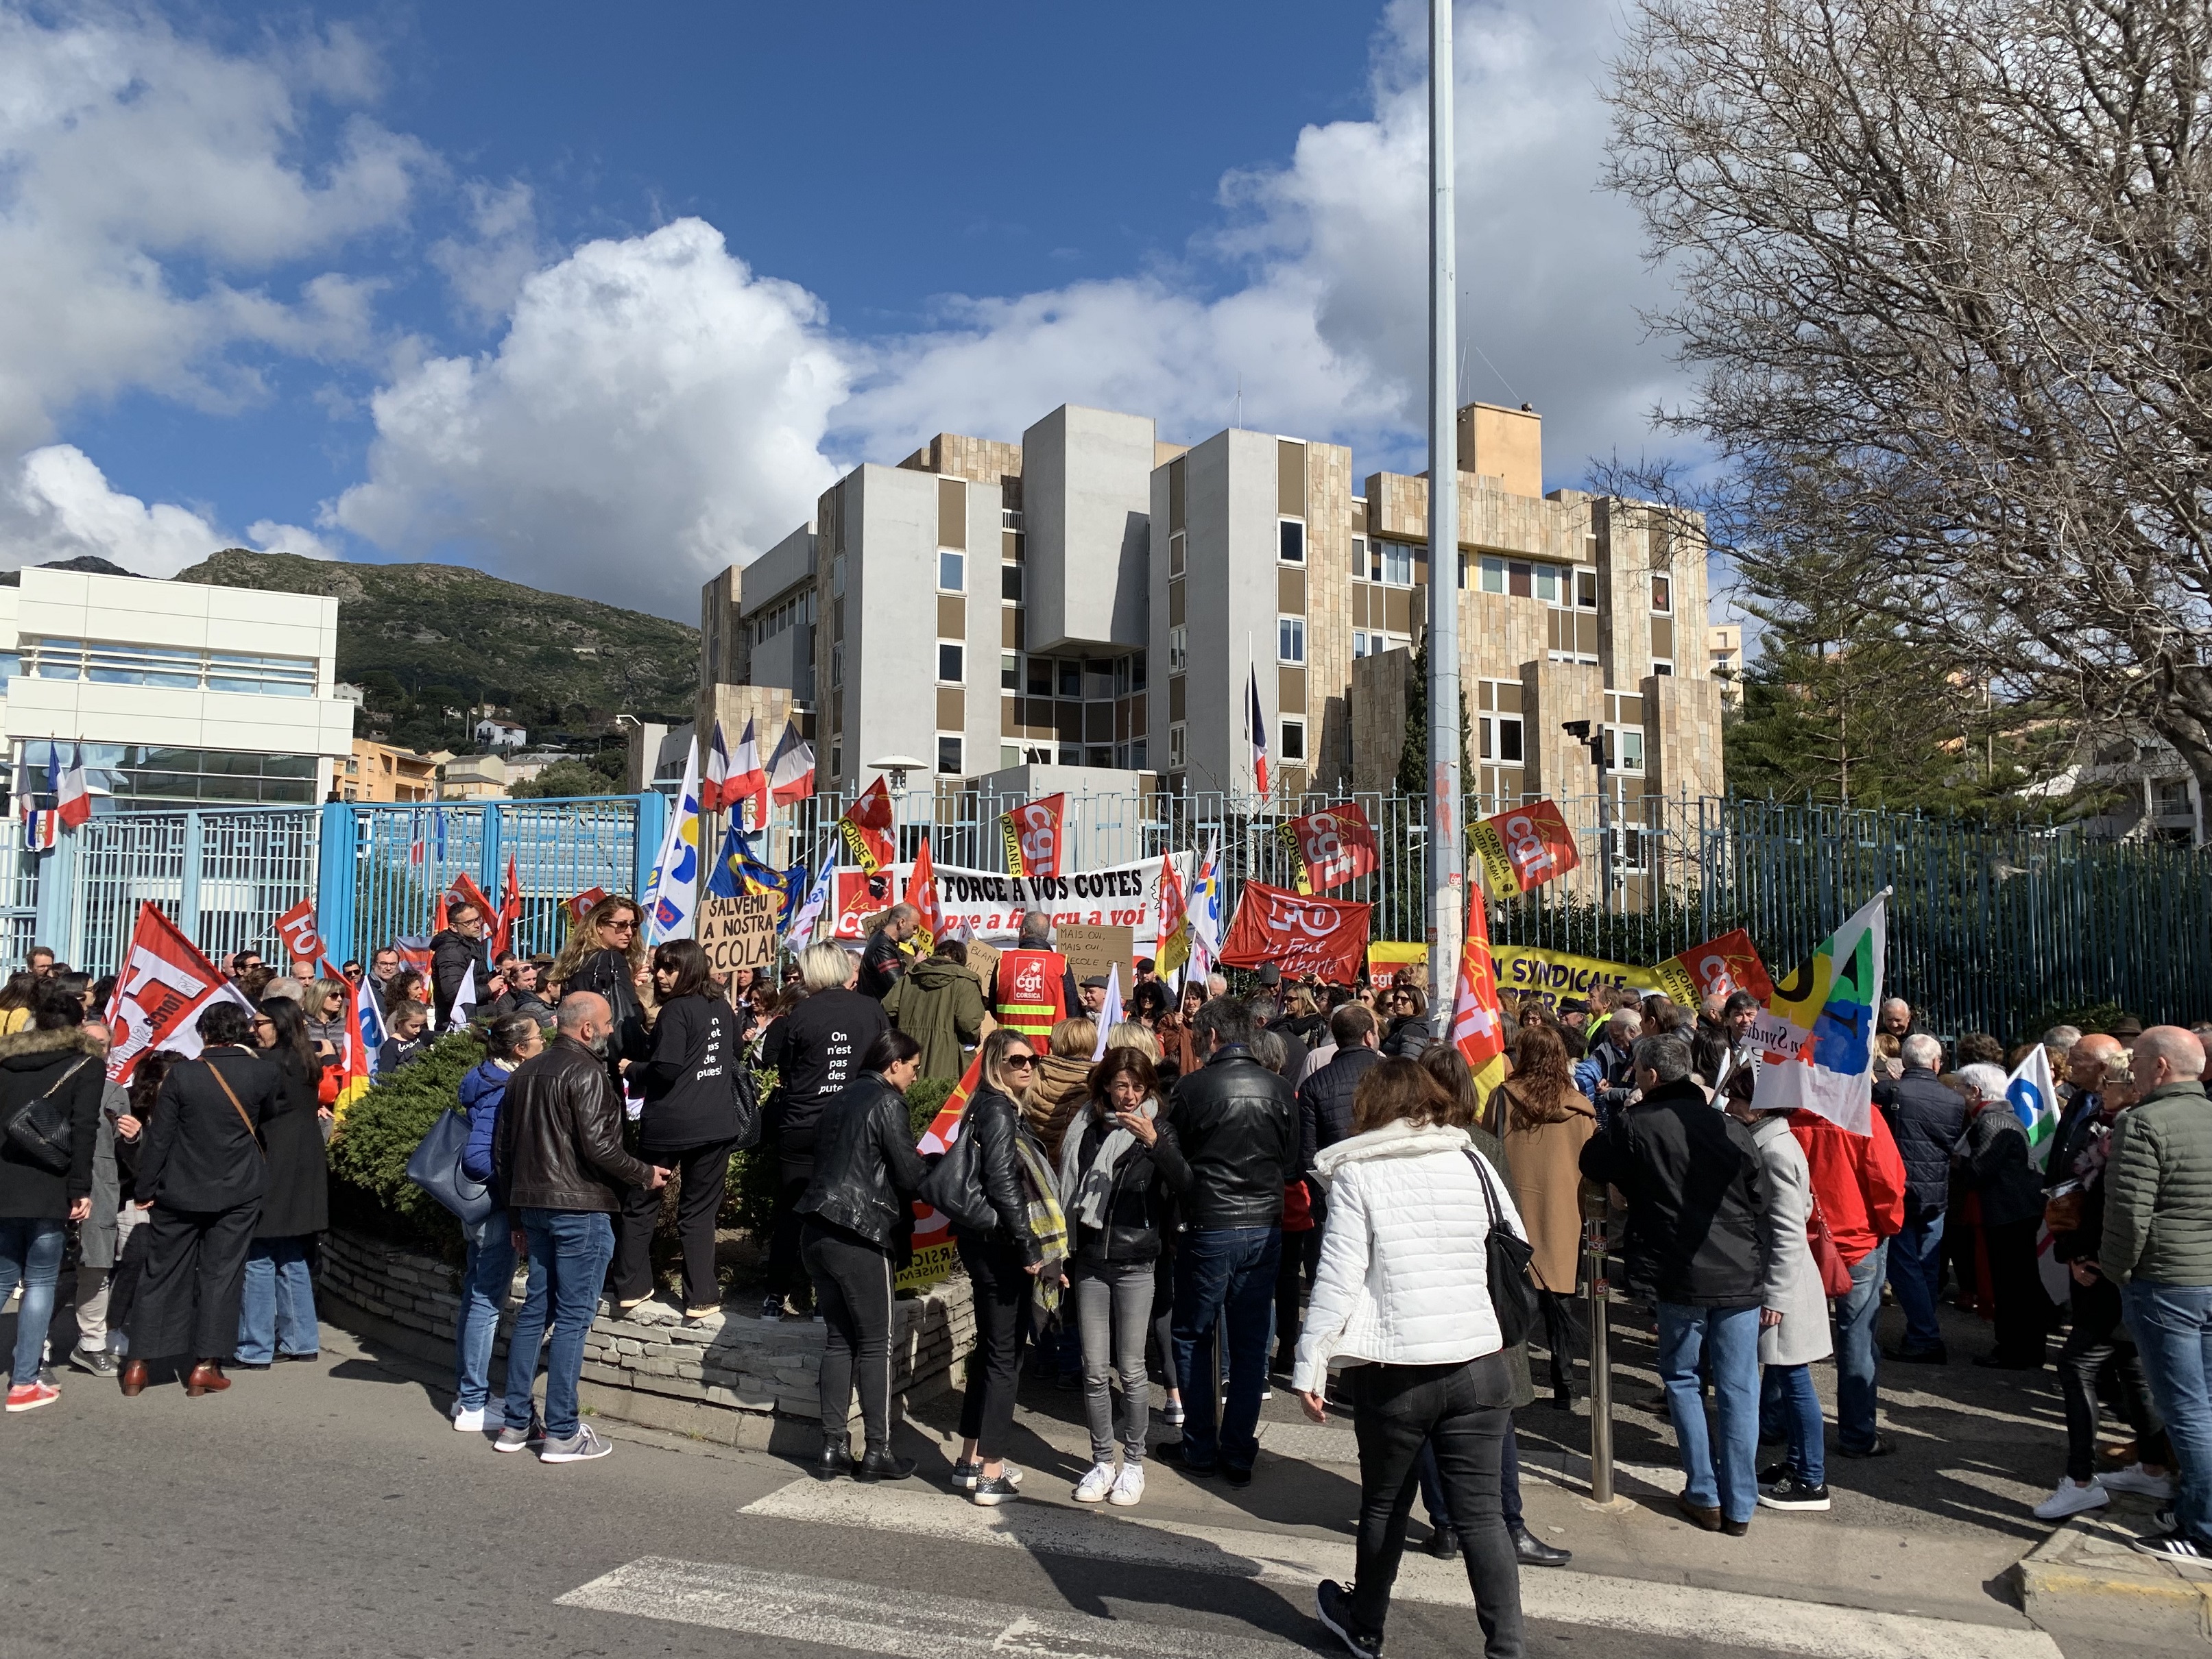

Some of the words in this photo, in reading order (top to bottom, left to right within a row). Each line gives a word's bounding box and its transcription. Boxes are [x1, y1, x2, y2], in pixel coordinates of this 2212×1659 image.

[841, 819, 870, 861] CORSE
[1002, 816, 1021, 875] DOUANES
[1307, 812, 1357, 882] cgt
[1473, 827, 1487, 849] TUTTI
[1506, 816, 1557, 878] cgt
[1282, 826, 1305, 873] CORSE
[1484, 827, 1510, 873] CORSICA
[944, 876, 1008, 903] FORCE
[1013, 877, 1026, 901] A
[1028, 876, 1068, 901] VOS
[709, 894, 767, 917] SALVEMU
[987, 914, 1001, 930] a
[1087, 910, 1102, 925] a
[1110, 902, 1146, 926] voi
[1268, 893, 1341, 937] FO
[283, 913, 317, 954] FO
[704, 922, 714, 939] A
[723, 914, 773, 936] NOSTRA
[1061, 928, 1083, 939] MAIS
[1088, 931, 1105, 941] OUI,
[701, 934, 776, 969] SCOLA!
[1061, 943, 1081, 952] MAIS
[1085, 944, 1103, 952] OUI,
[1070, 957, 1100, 966] ECOLE
[1279, 954, 1352, 975] liberté
[1016, 974, 1042, 992] cgt
[1371, 972, 1393, 988] cgt
[1663, 969, 1680, 991] TUTTI
[831, 1031, 847, 1041] On
[827, 1045, 852, 1055] n'est
[828, 1069, 846, 1080] des
[829, 1059, 847, 1070] pas
[818, 1084, 843, 1095] pute
